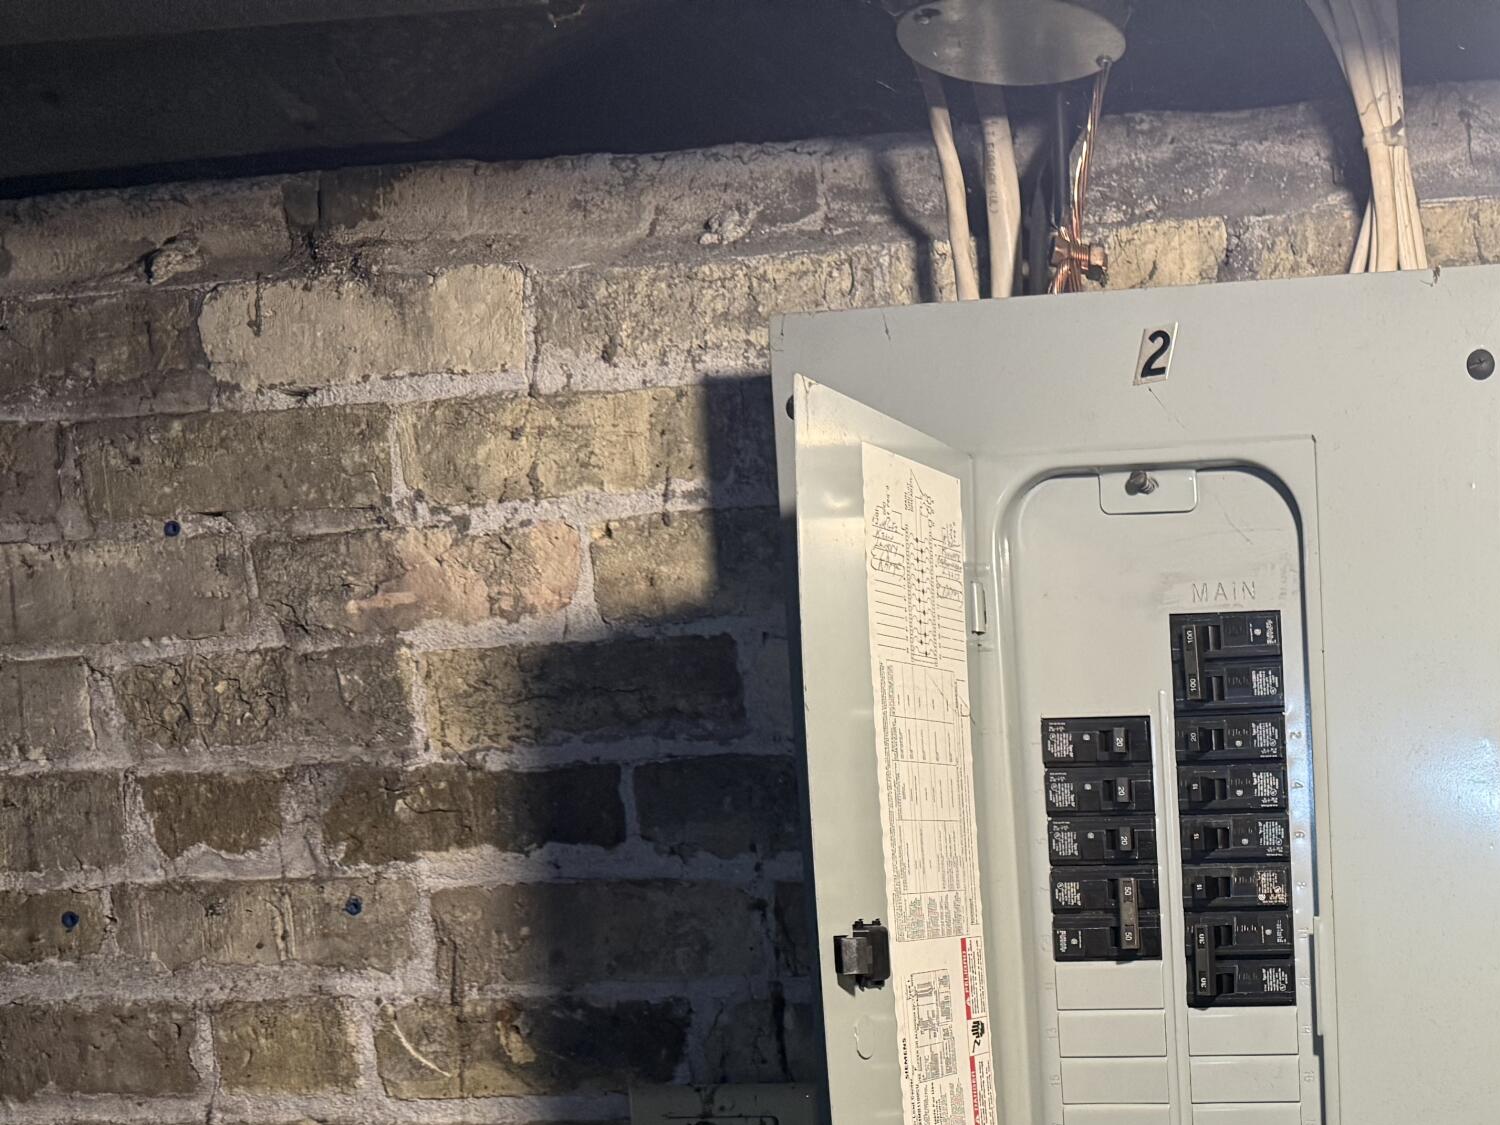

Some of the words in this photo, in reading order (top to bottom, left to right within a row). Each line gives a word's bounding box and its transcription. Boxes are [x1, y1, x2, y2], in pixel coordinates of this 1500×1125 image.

[1141, 330, 1170, 378] 2
[1191, 580, 1257, 603] MAIN
[1189, 678, 1197, 692] 100
[1190, 732, 1197, 742] 20
[1289, 731, 1301, 739] 2
[1116, 737, 1124, 747] 20
[1118, 786, 1125, 796] 20
[1120, 835, 1128, 846] 20
[1124, 931, 1133, 941] 50
